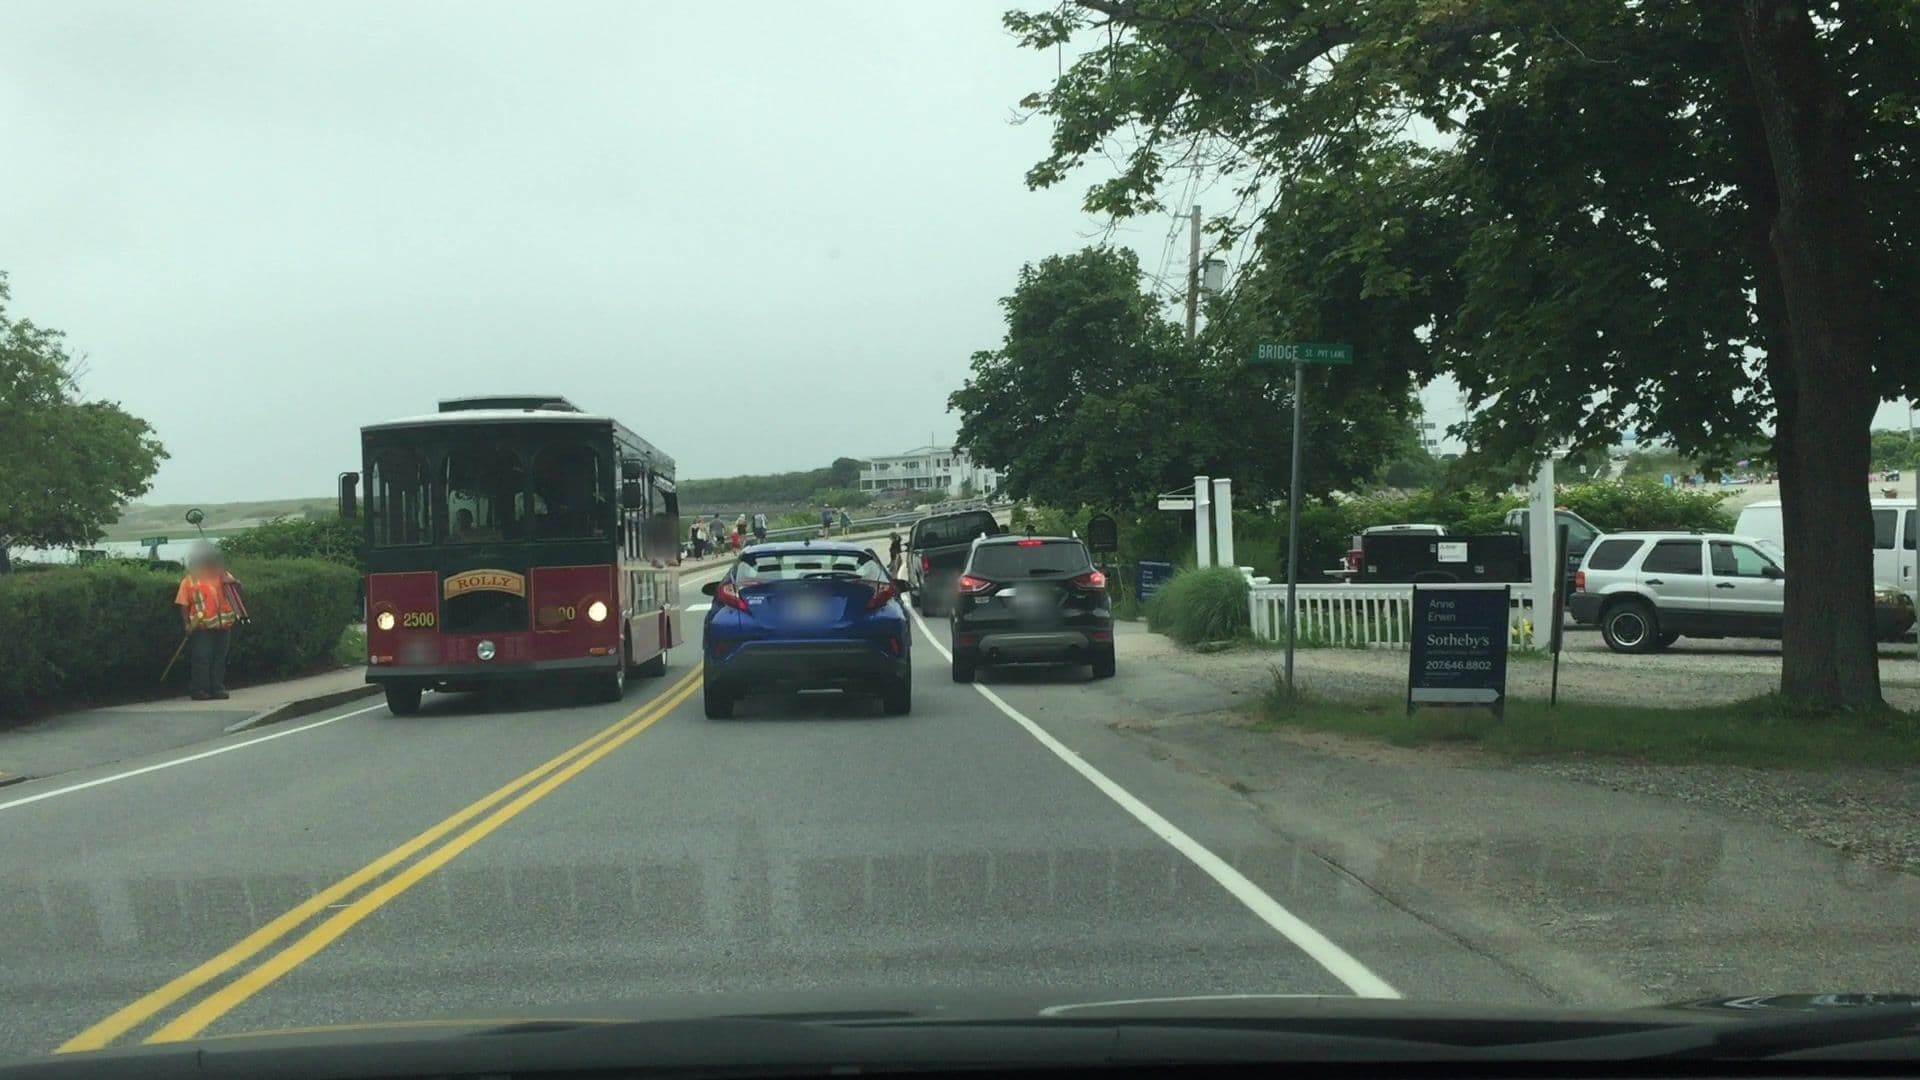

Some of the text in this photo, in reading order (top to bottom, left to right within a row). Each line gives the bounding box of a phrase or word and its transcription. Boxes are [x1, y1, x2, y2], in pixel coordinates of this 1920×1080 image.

[1258, 344, 1299, 360] BRIDGE
[457, 576, 511, 588] ROLLY
[1429, 600, 1455, 609] Anne
[404, 612, 434, 627] 2500
[1428, 612, 1456, 622] Erwin
[1426, 633, 1490, 648] Sotheby's
[1425, 660, 1492, 671] 207.646.8802
